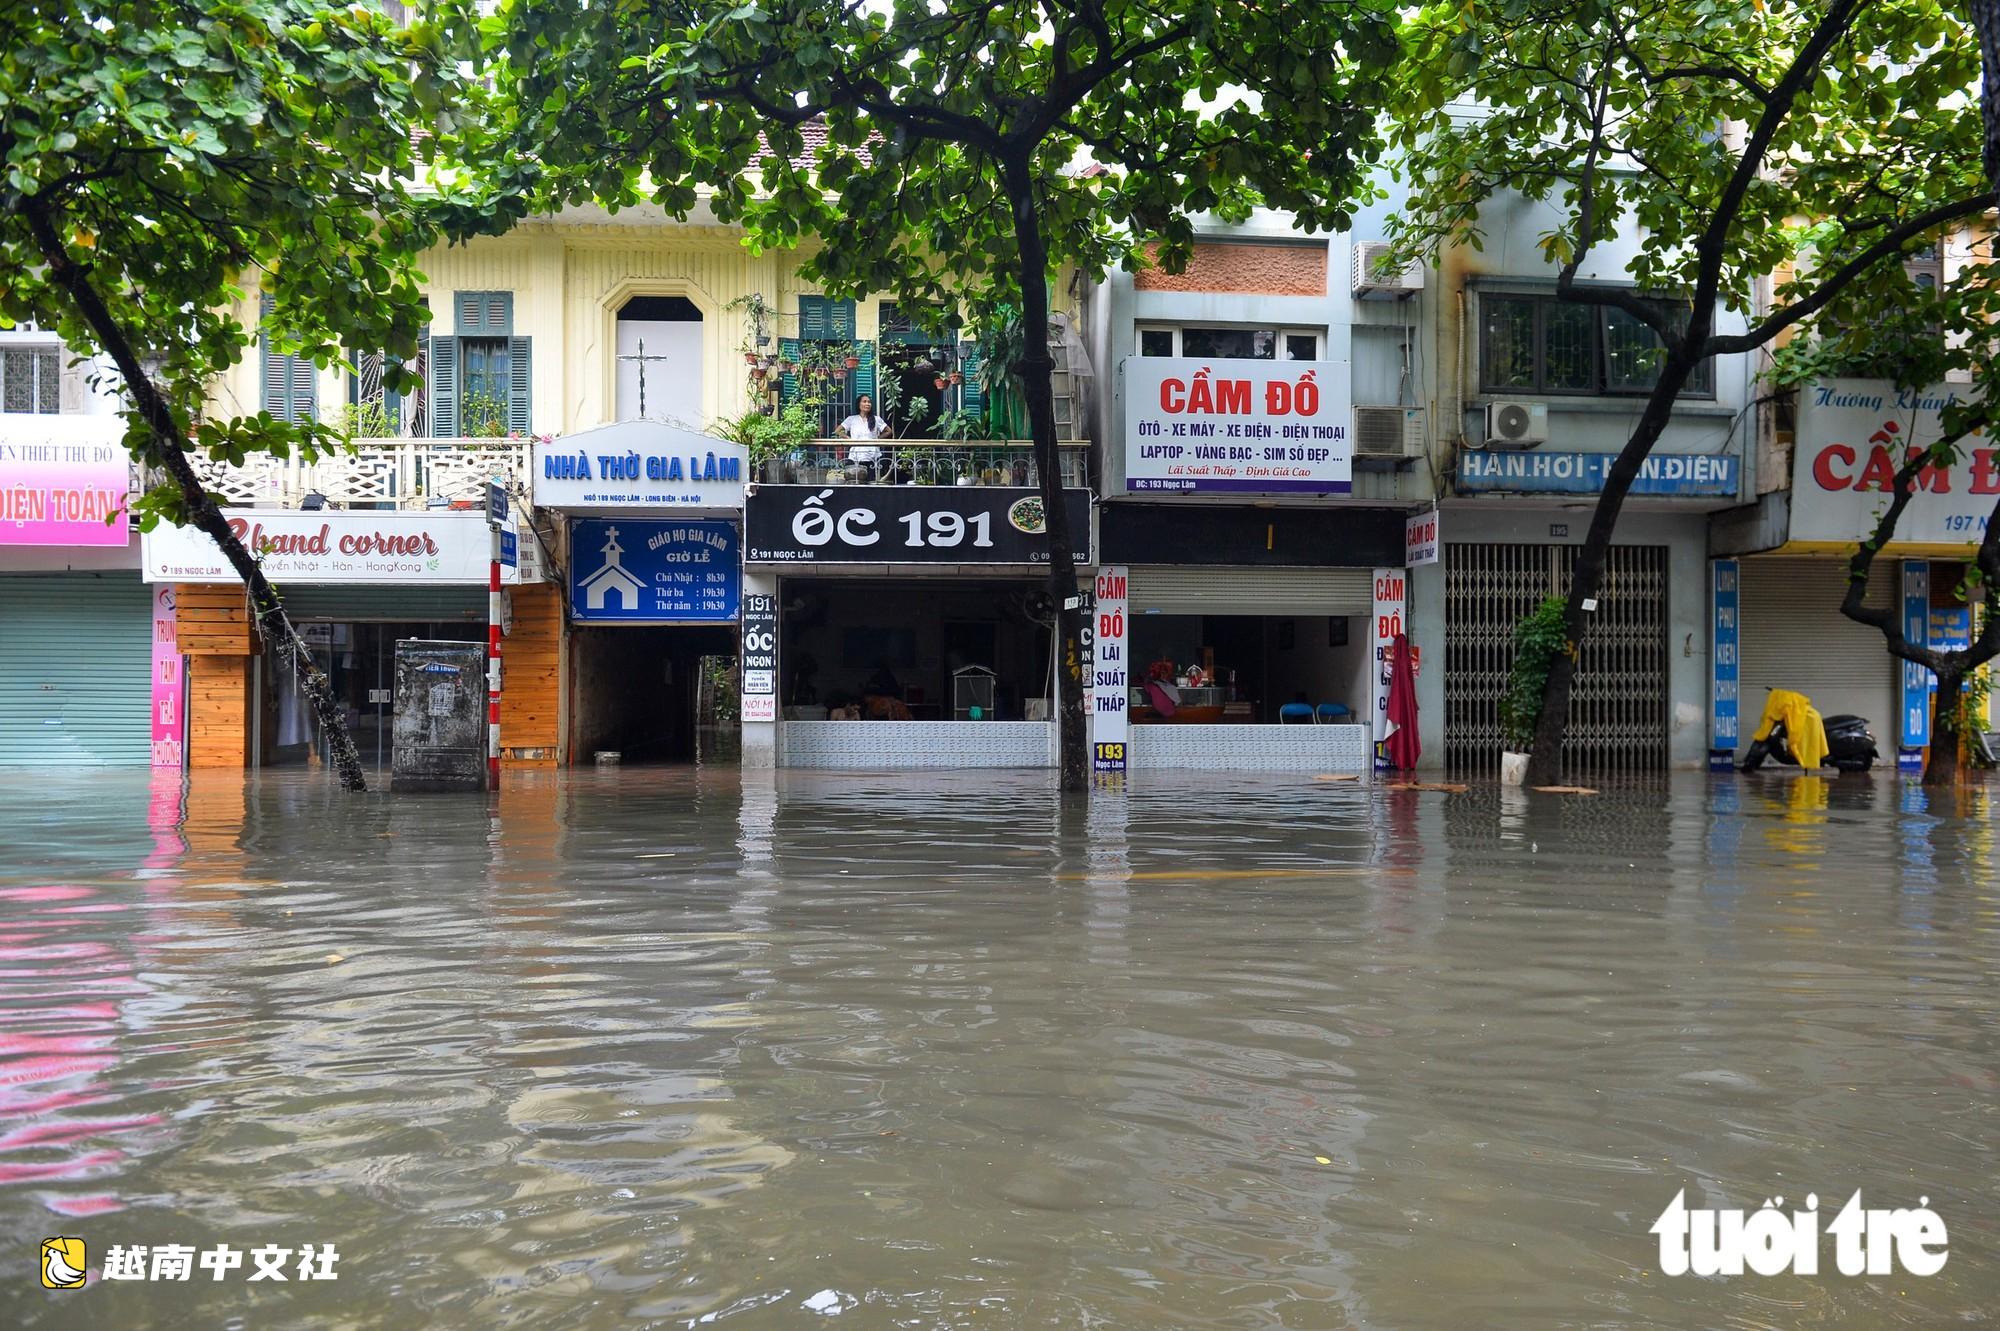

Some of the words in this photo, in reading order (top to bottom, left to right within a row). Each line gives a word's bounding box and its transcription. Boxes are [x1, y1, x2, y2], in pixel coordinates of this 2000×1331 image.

[1159, 366, 1252, 416] CẦM
[1264, 369, 1320, 417] ĐỒ
[1815, 387, 1884, 412] Hương
[1138, 420, 1161, 436] ÔTÔ
[1172, 423, 1187, 437] XE
[1190, 421, 1216, 438] MÁY
[1227, 424, 1241, 438] XE
[1245, 422, 1272, 441] ĐIỆN
[1283, 423, 1309, 441] ĐIỆN
[1313, 426, 1345, 442] THOẠI
[1141, 445, 1184, 459] LAPTOP
[1195, 443, 1226, 460] VÀNG
[1230, 447, 1253, 463] BẠC
[1264, 447, 1286, 461] SIM
[1289, 443, 1305, 461] SỐ
[1308, 447, 1330, 465] ĐẸP
[1813, 421, 1951, 494] CẦM
[1968, 448, 2000, 494] Đ
[545, 450, 592, 480] NHÀ
[598, 450, 640, 481] THỜ
[646, 455, 684, 481] GIA
[690, 451, 740, 481] LÂM
[1167, 465, 1184, 475] Lãi
[1187, 465, 1208, 476] Suất
[1212, 465, 1237, 478] Thấp
[1246, 466, 1270, 478] Định
[1272, 466, 1289, 477] Giá
[1292, 467, 1311, 477] Cao
[1136, 480, 1148, 489] ĐC:
[1150, 481, 1162, 489] 193
[1163, 480, 1180, 490] Ngọc
[1182, 480, 1196, 489] Lâm
[52, 485, 114, 522] TOÁN
[792, 489, 880, 546] ỐC
[899, 511, 994, 546] 191
[1945, 515, 1974, 531] 197
[339, 530, 439, 556] corner
[648, 532, 671, 551] GIÁO
[673, 529, 686, 544] HỌ
[688, 529, 704, 543] GIA
[706, 532, 728, 551] LÂM
[666, 550, 691, 563] GIỜ
[694, 548, 711, 563] LỄ
[759, 550, 772, 559] 191
[773, 550, 796, 561] NGỌC
[797, 549, 814, 559] LÂM
[293, 560, 319, 572] Nhật
[655, 572, 672, 582] Chủ
[674, 572, 693, 584] Nhật
[706, 573, 725, 582] 8h30
[1097, 569, 1126, 600] CẦM
[1376, 570, 1403, 601] CẦM
[656, 587, 672, 597] Thứ
[674, 588, 684, 597] ba
[702, 587, 725, 597] 19h30
[674, 601, 691, 610] năm
[702, 600, 725, 610] 19h30
[748, 597, 770, 611] 191
[156, 620, 176, 643] TRUN
[1100, 607, 1123, 638] ĐỒ
[1378, 608, 1401, 639] ĐỒ
[745, 624, 773, 651] ỐC
[1080, 628, 1092, 646] C
[746, 656, 771, 667] NGON
[1103, 643, 1120, 661] LÃI
[1096, 667, 1126, 686] SUẤT
[1096, 692, 1125, 712] THẤP
[1097, 744, 1125, 760] 193
